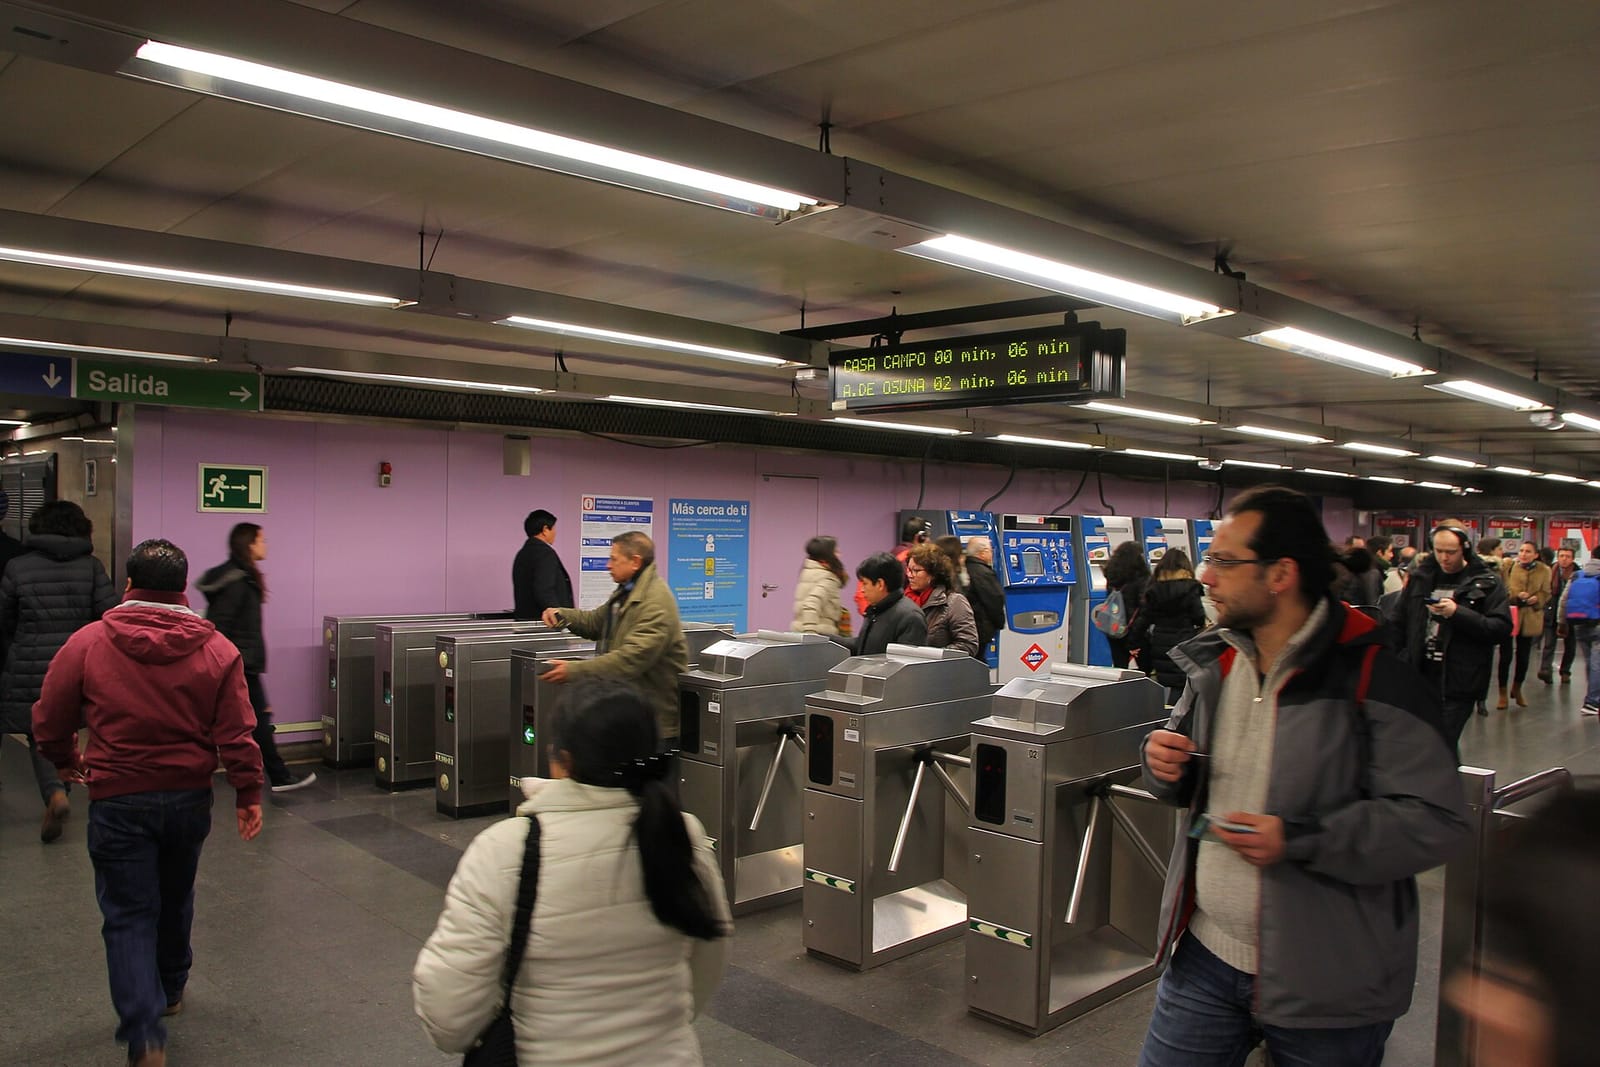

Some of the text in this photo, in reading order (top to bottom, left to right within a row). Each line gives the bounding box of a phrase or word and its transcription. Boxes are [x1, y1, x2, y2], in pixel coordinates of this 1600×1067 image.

[843, 338, 1069, 373] CASA CAMPO 00 min, 06 min
[88, 370, 169, 396] Salida
[882, 378, 925, 394] OSUNA
[933, 375, 952, 391] 02
[960, 373, 995, 389] min,
[1007, 369, 1028, 385] 06
[1037, 367, 1068, 383] min
[672, 502, 748, 516] Más cerca de ti
